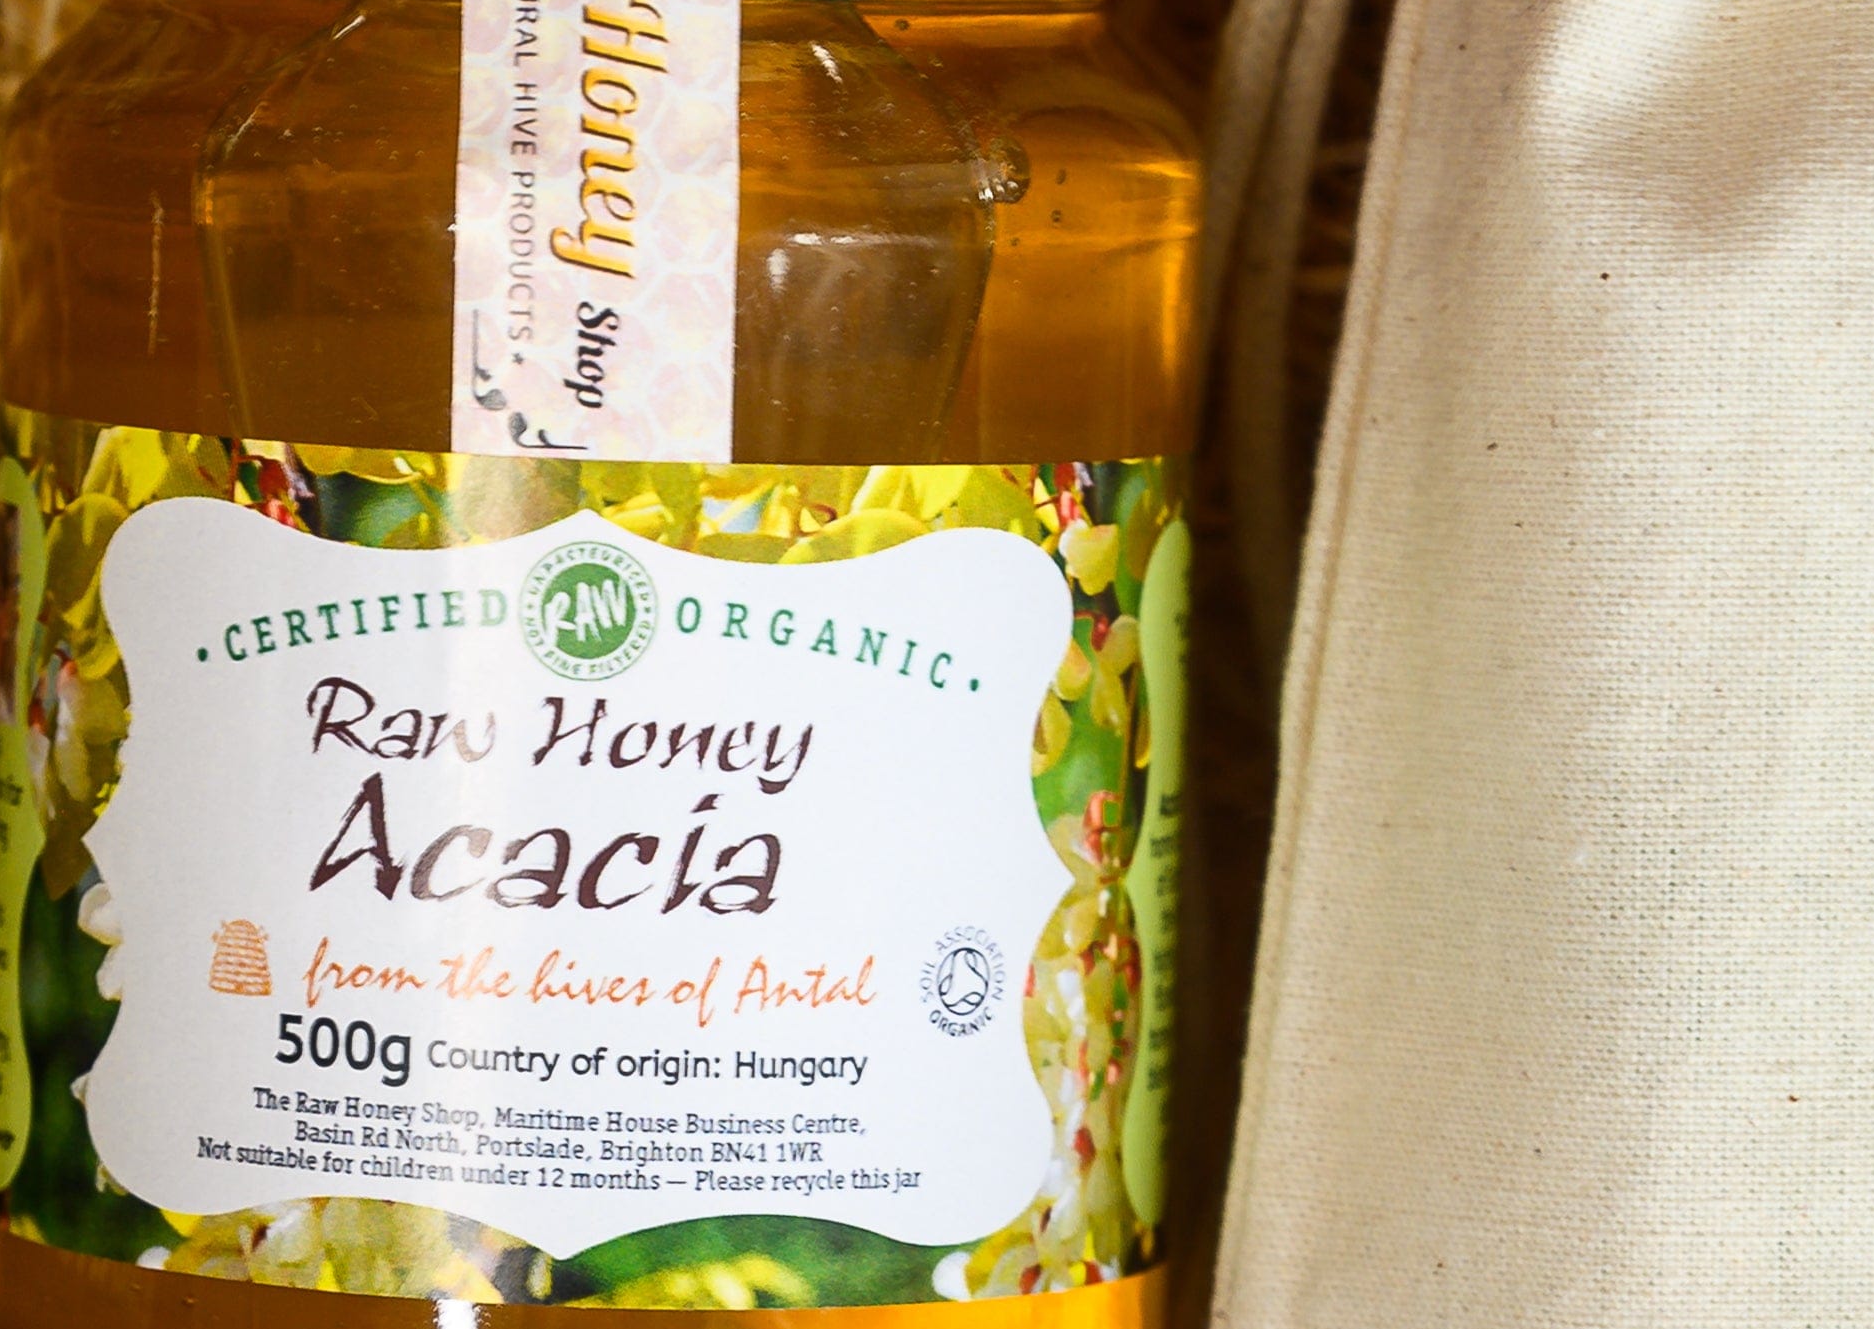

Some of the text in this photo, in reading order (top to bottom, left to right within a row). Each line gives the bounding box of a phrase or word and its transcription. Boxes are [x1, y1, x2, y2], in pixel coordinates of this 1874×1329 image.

[511, 80, 539, 156] HIVE
[506, 170, 537, 343] PRODUCTS
[561, 299, 624, 411] Shop
[224, 587, 955, 691] CERTIFIED ORGANIC
[544, 579, 627, 647] RAW
[305, 676, 816, 794] Raw Honey
[308, 770, 782, 917] Acacia
[302, 936, 877, 1028] from the hives of Antal
[275, 1012, 869, 1087] 500g Country of origin: Hungary
[929, 1006, 992, 1037] ORGANIC
[253, 1086, 867, 1137] The Raw Honey Shop, Maritime House Business Centre,
[295, 1120, 824, 1167] Basin Rd North, Portslade, Brighton BN41 1WR
[196, 1136, 232, 1161] Not
[236, 1144, 317, 1172] suitable
[322, 1151, 353, 1174] for
[360, 1153, 454, 1182] children
[460, 1161, 529, 1187] under
[538, 1167, 564, 1189] 12
[570, 1168, 661, 1191] months
[694, 1169, 765, 1192] Please
[771, 1168, 845, 1196] recycle
[850, 1167, 891, 1190] this
[892, 1167, 922, 1194] jar
